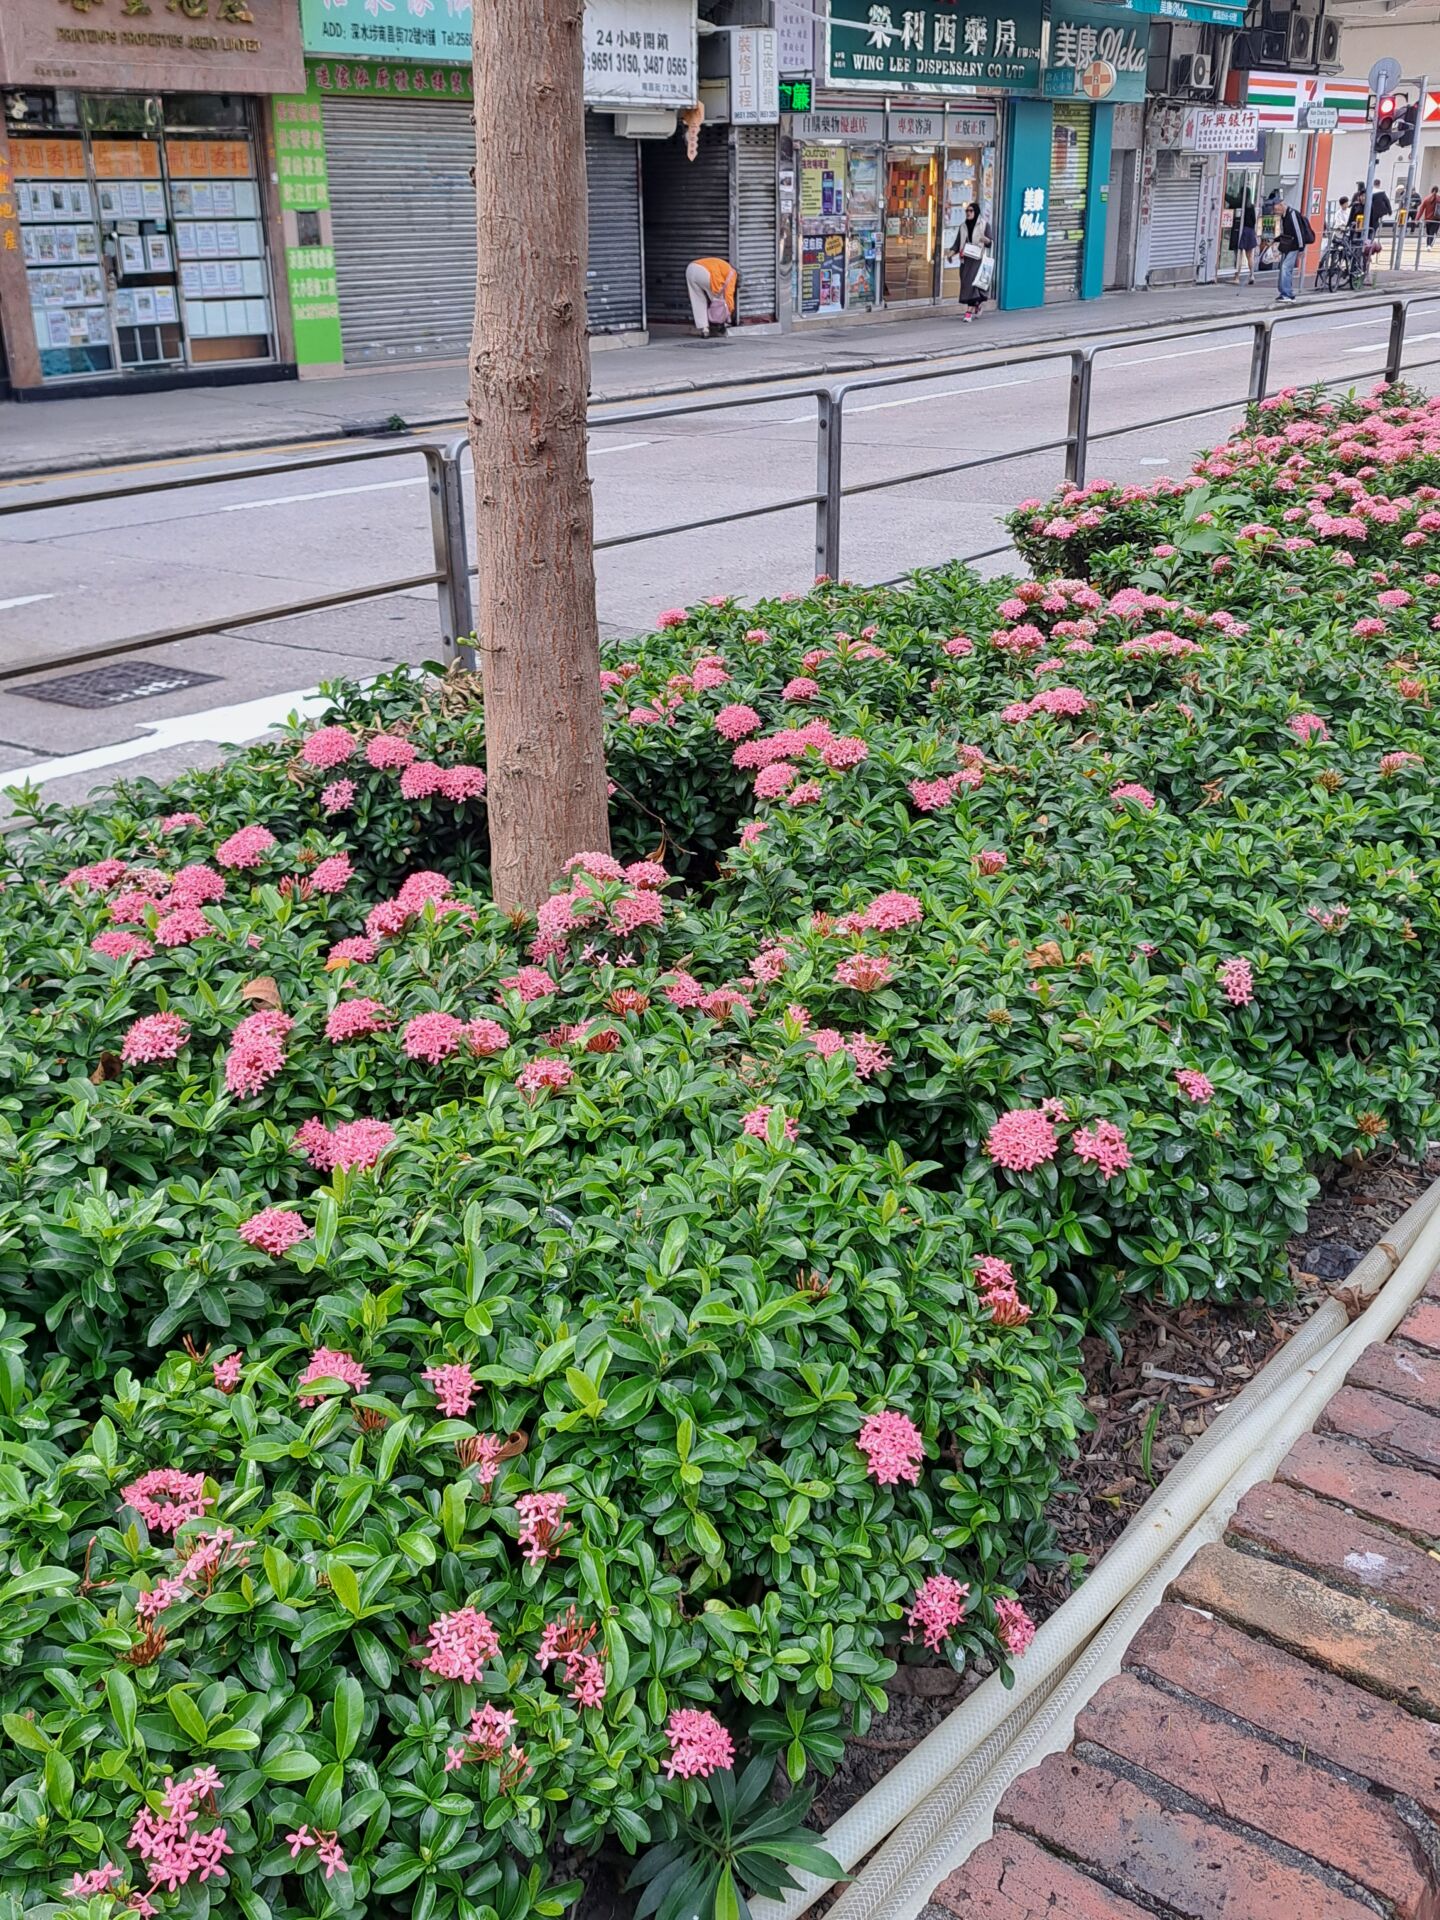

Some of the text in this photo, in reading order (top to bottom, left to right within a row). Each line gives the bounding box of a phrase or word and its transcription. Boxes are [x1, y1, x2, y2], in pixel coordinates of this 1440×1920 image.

[1055, 22, 1099, 67] 美康
[1098, 27, 1146, 72] Meka
[643, 55, 664, 75] 3487
[667, 57, 688, 76] 0565
[852, 53, 884, 71] WING
[889, 57, 911, 73] LEE
[916, 59, 984, 77] DISPENSARY
[987, 64, 1002, 78] CO
[1006, 64, 1025, 80] LTD
